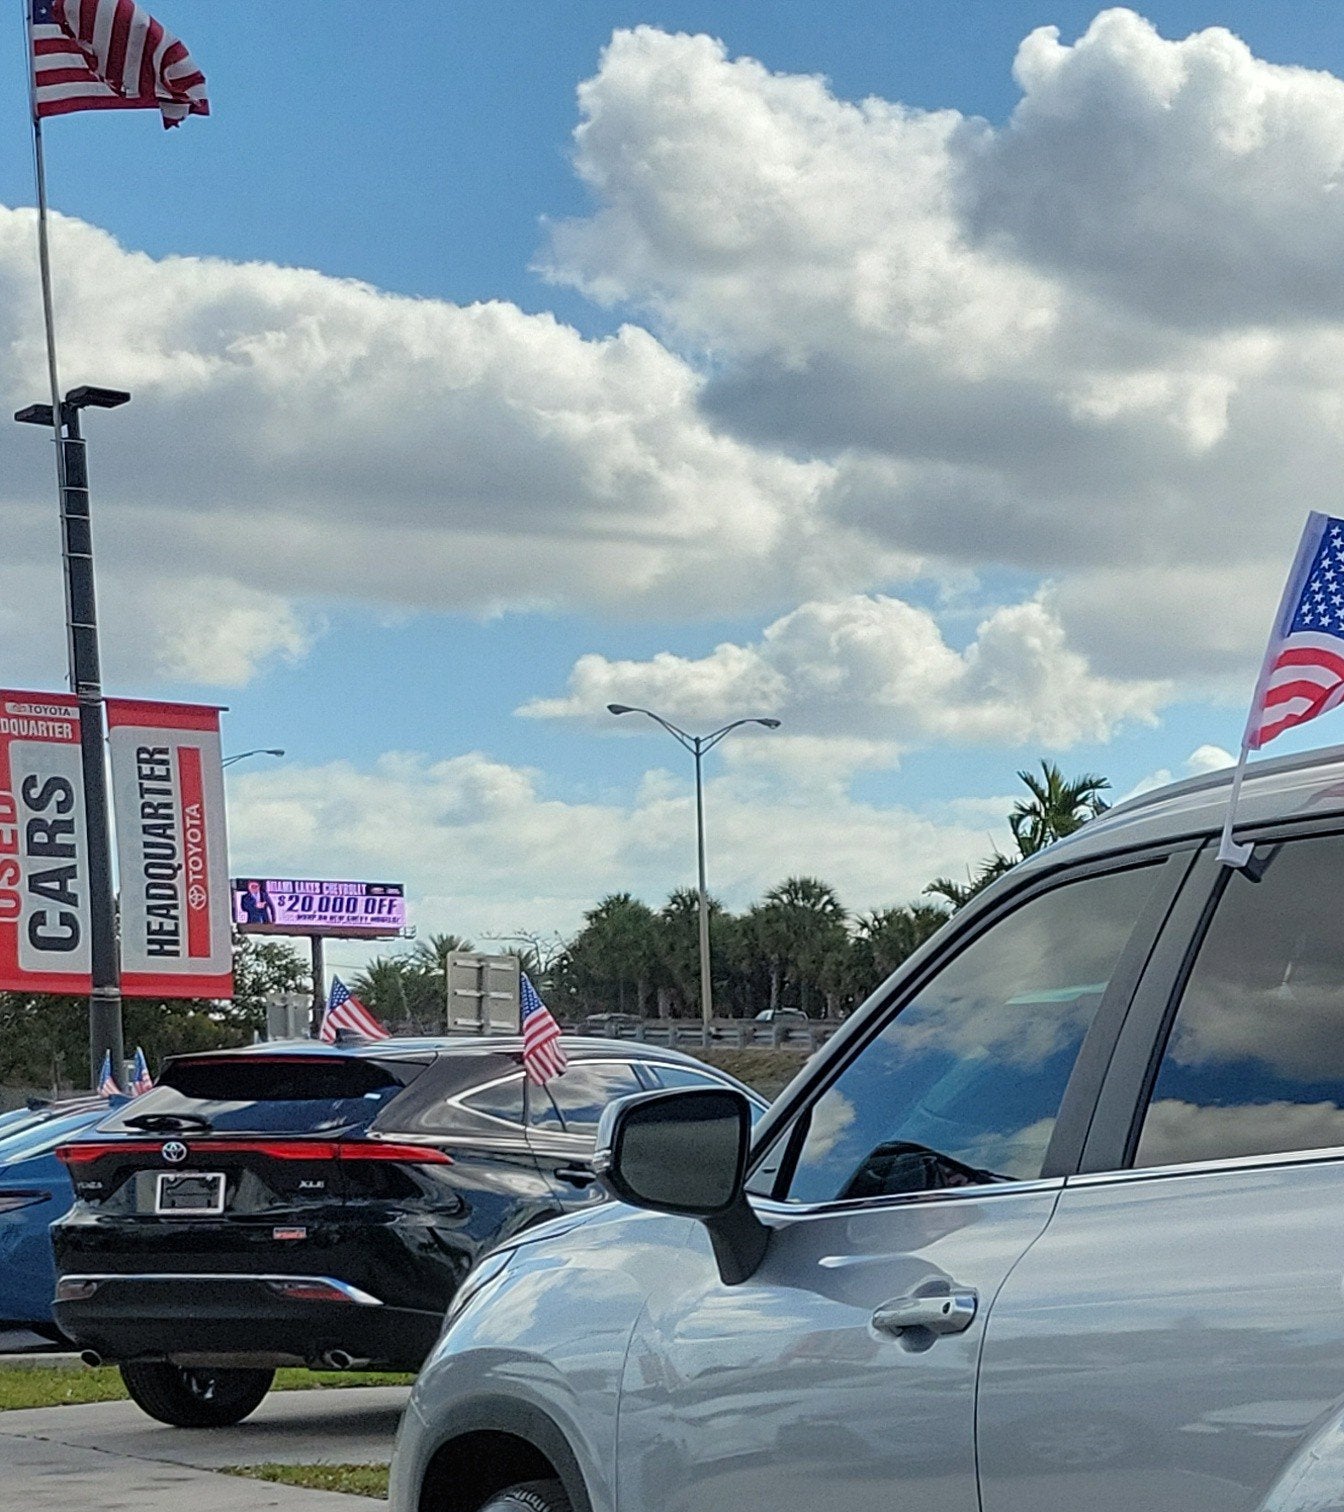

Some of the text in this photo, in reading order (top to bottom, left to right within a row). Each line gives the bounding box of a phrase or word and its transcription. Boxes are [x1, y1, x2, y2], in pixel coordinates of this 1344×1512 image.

[28, 704, 71, 717] TOYOTA
[22, 774, 81, 952] CARS
[136, 745, 183, 958] HEADQUARTER
[184, 803, 204, 884] TOYOTA
[277, 895, 398, 915] $20,000 OFF
